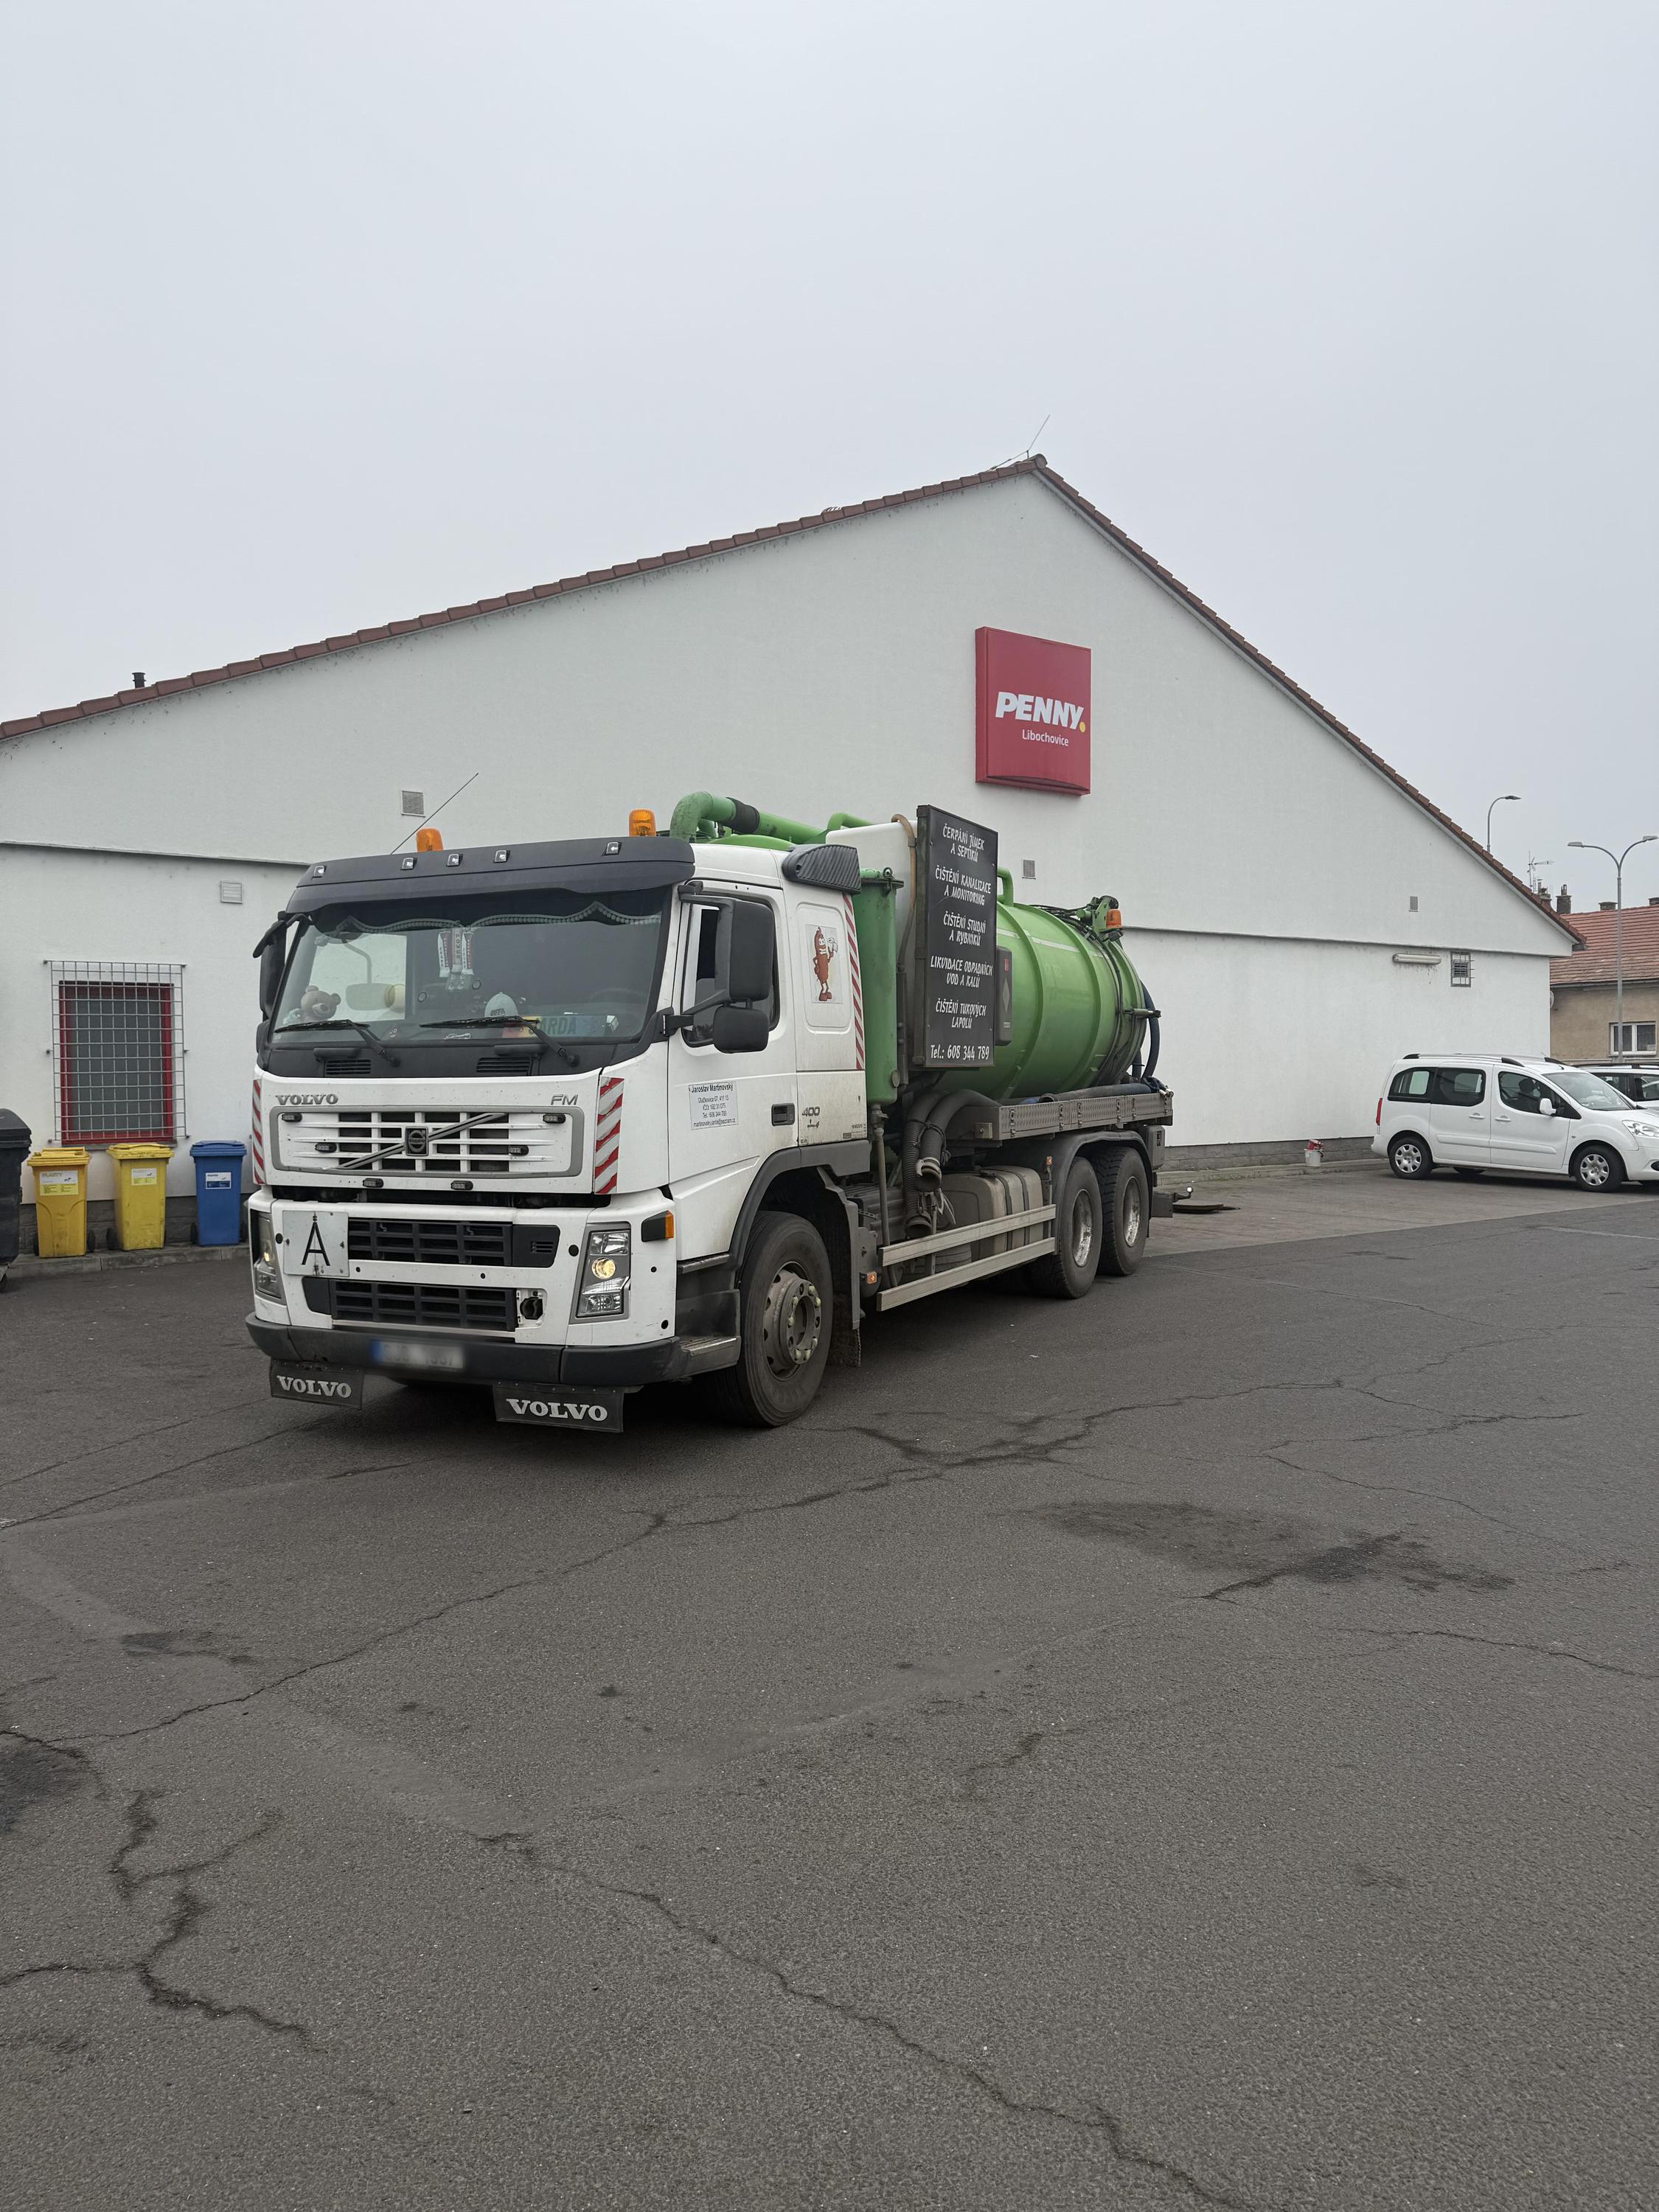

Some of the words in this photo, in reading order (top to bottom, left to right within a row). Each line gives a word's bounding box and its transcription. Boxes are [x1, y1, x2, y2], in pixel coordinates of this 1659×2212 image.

[1022, 729, 1069, 746] Libochovice
[942, 823, 968, 843] ČERPÁNÍ
[969, 833, 985, 851] JÍMEK
[950, 843, 956, 855] A
[957, 845, 978, 863] SEPTIKŮ
[935, 865, 959, 884] ČIŠTĚNÍ
[961, 874, 991, 894] KANALIZACE
[944, 885, 949, 896] A
[951, 886, 985, 905] MONITORING
[943, 911, 966, 929] ČIŠTĚNÍ
[967, 919, 986, 933] STUDNÍ
[949, 929, 954, 941] A
[956, 931, 981, 946] RYBNÍKŮ
[930, 956, 963, 971] LIKVIDACE
[964, 961, 993, 976] ODPADNÍCH
[946, 973, 959, 985] VOD
[960, 975, 964, 986] A
[936, 998, 959, 1014] ČIŠTĚNÍ
[960, 1001, 987, 1018] TUKOVÝCH
[931, 1044, 945, 1059] Tel.:
[947, 1045, 961, 1059] 608
[962, 1045, 975, 1060] 344
[978, 1046, 990, 1060] 789
[275, 1093, 338, 1105] VOLVO
[551, 1094, 578, 1105] FM
[692, 1085, 709, 1093] Jaroslav
[801, 1107, 820, 1117] 400
[301, 1222, 330, 1266] A
[276, 1375, 352, 1398] VOLVO
[506, 1398, 608, 1422] VOLVO
